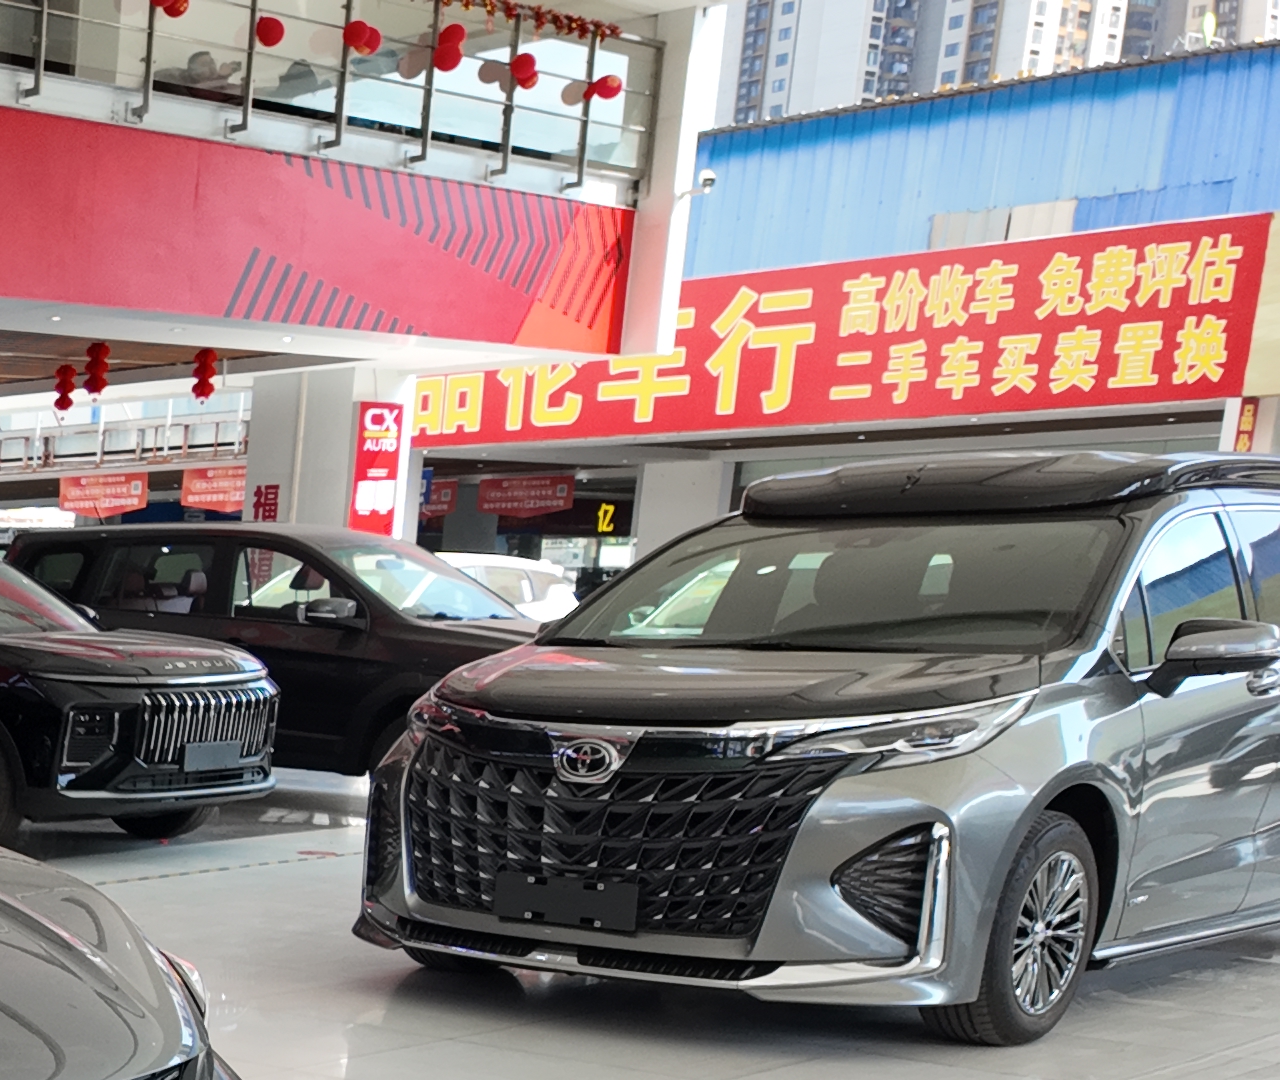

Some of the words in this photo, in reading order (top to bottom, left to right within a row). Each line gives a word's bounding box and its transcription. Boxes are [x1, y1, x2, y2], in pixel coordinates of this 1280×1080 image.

[839, 259, 1019, 337] 高价收车
[1035, 233, 1243, 320] 免费评估
[830, 314, 1229, 404] 二手车买卖置换
[363, 439, 397, 452] AUTO
[364, 408, 399, 431] CX
